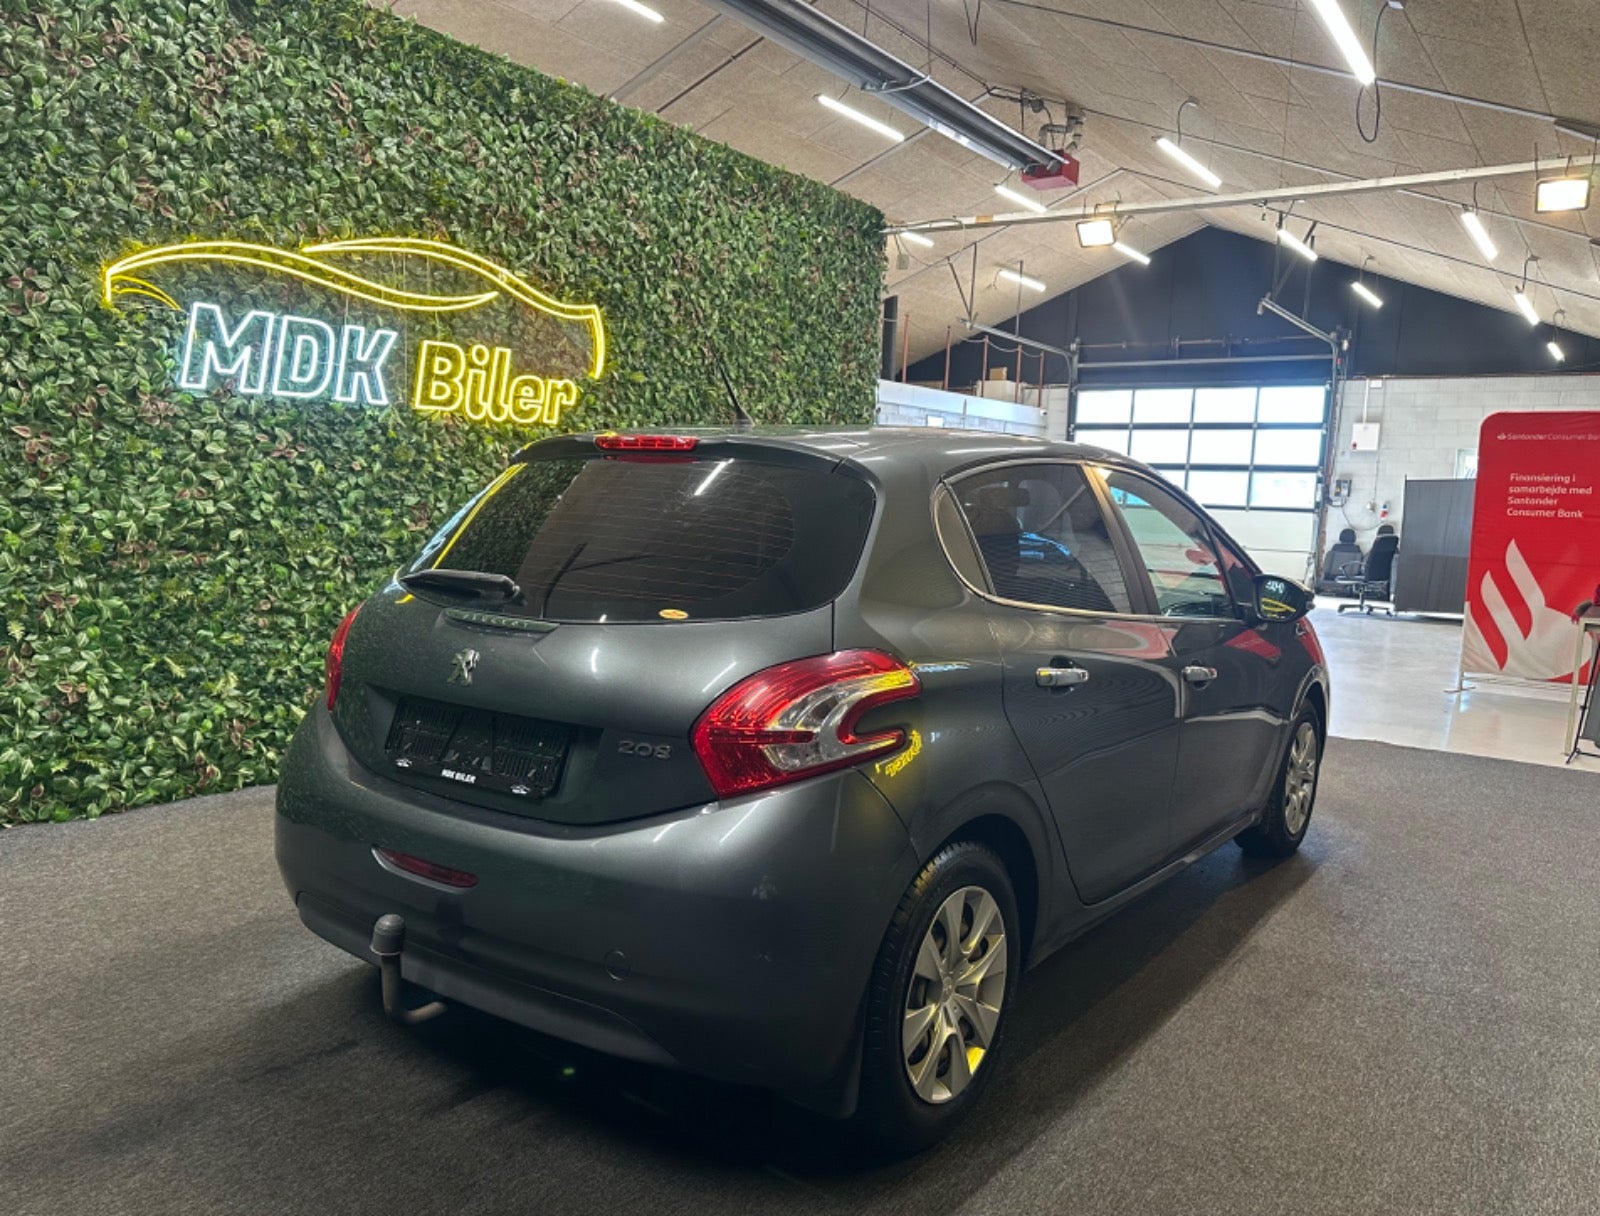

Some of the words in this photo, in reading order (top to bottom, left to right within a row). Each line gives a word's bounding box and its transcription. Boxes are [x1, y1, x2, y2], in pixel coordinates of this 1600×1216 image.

[180, 301, 398, 405] MDK
[414, 340, 577, 425] Biler
[1510, 473, 1570, 484] Finansiering
[1508, 485, 1567, 495] samarbejde
[1569, 486, 1593, 494] med
[1507, 496, 1558, 505] Santander
[1507, 508, 1555, 517] Consumer
[1557, 509, 1583, 518] Bank
[619, 741, 671, 759] 208
